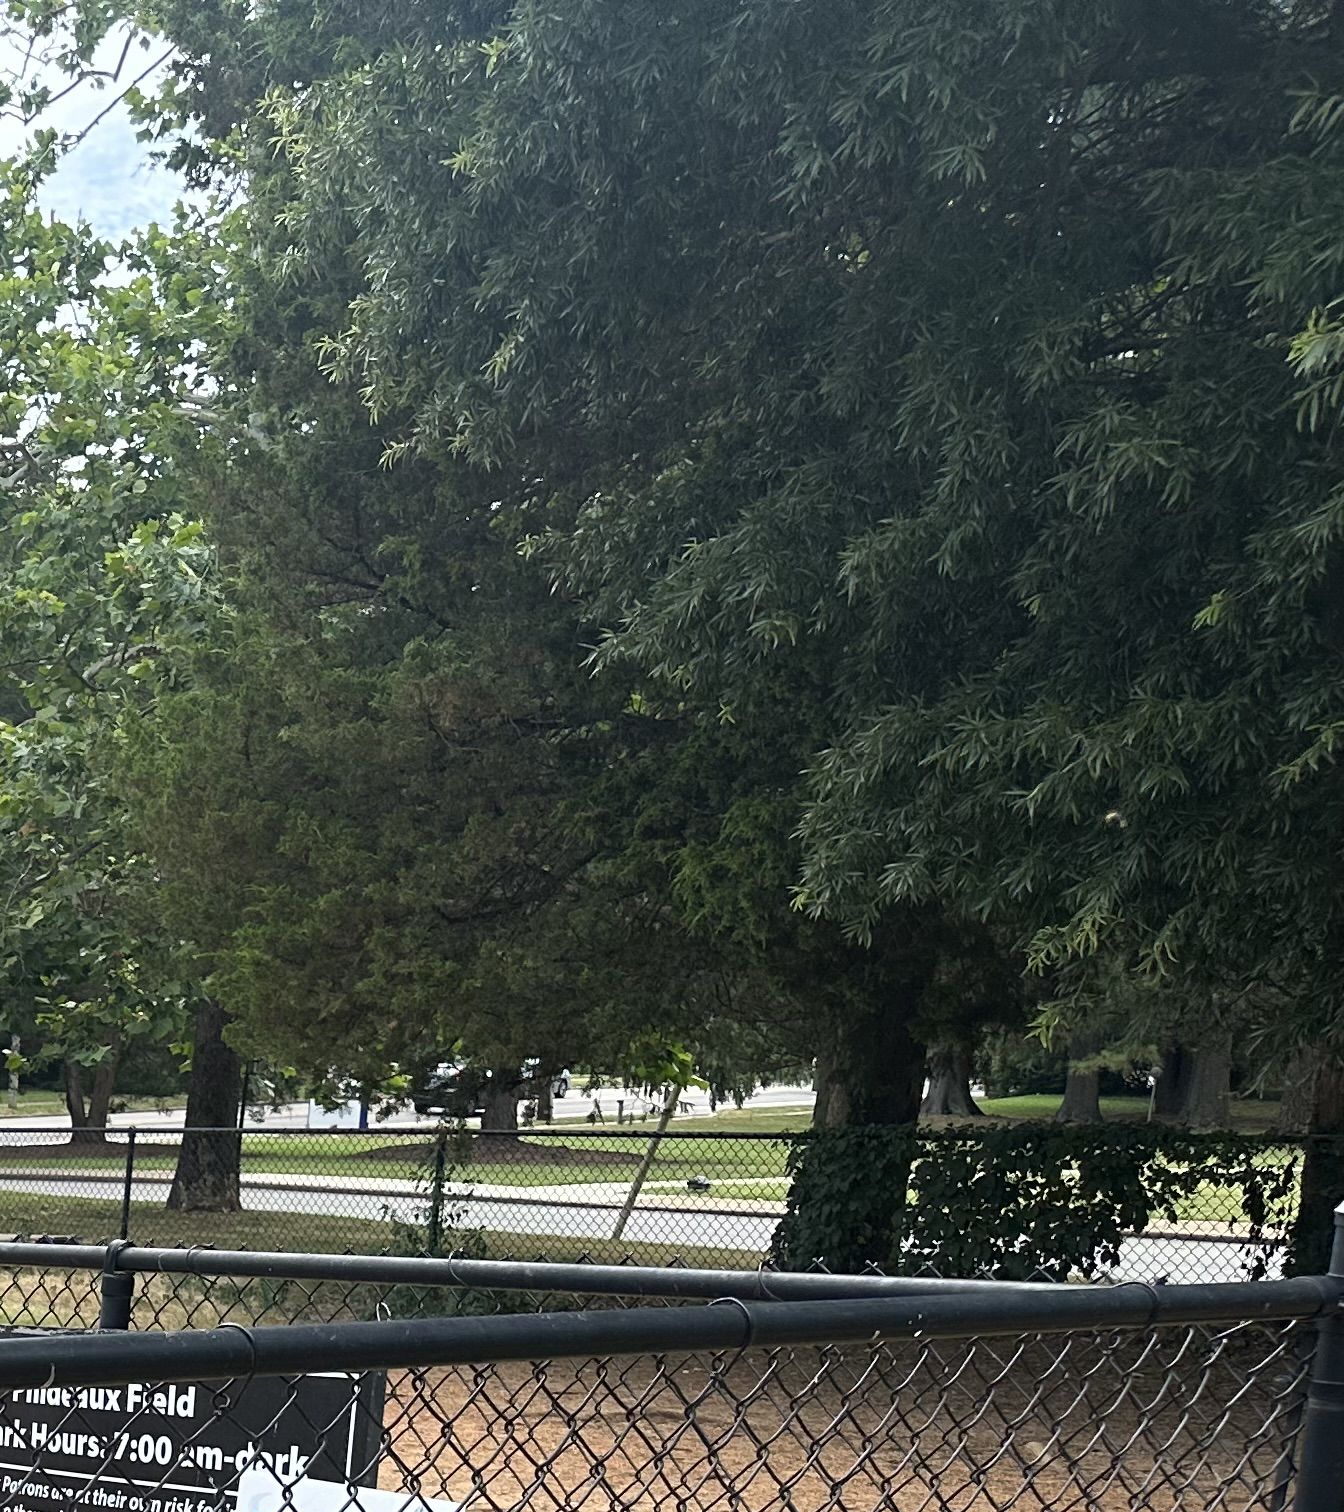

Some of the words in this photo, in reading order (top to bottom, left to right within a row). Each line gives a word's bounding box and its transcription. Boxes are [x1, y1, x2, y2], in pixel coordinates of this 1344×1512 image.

[127, 1382, 196, 1417] Field
[30, 1421, 108, 1459] Hours:
[113, 1431, 173, 1466] 7:00
[178, 1441, 311, 1478] am-dark
[1, 1475, 50, 1499] Patrons
[92, 1487, 128, 1508] their
